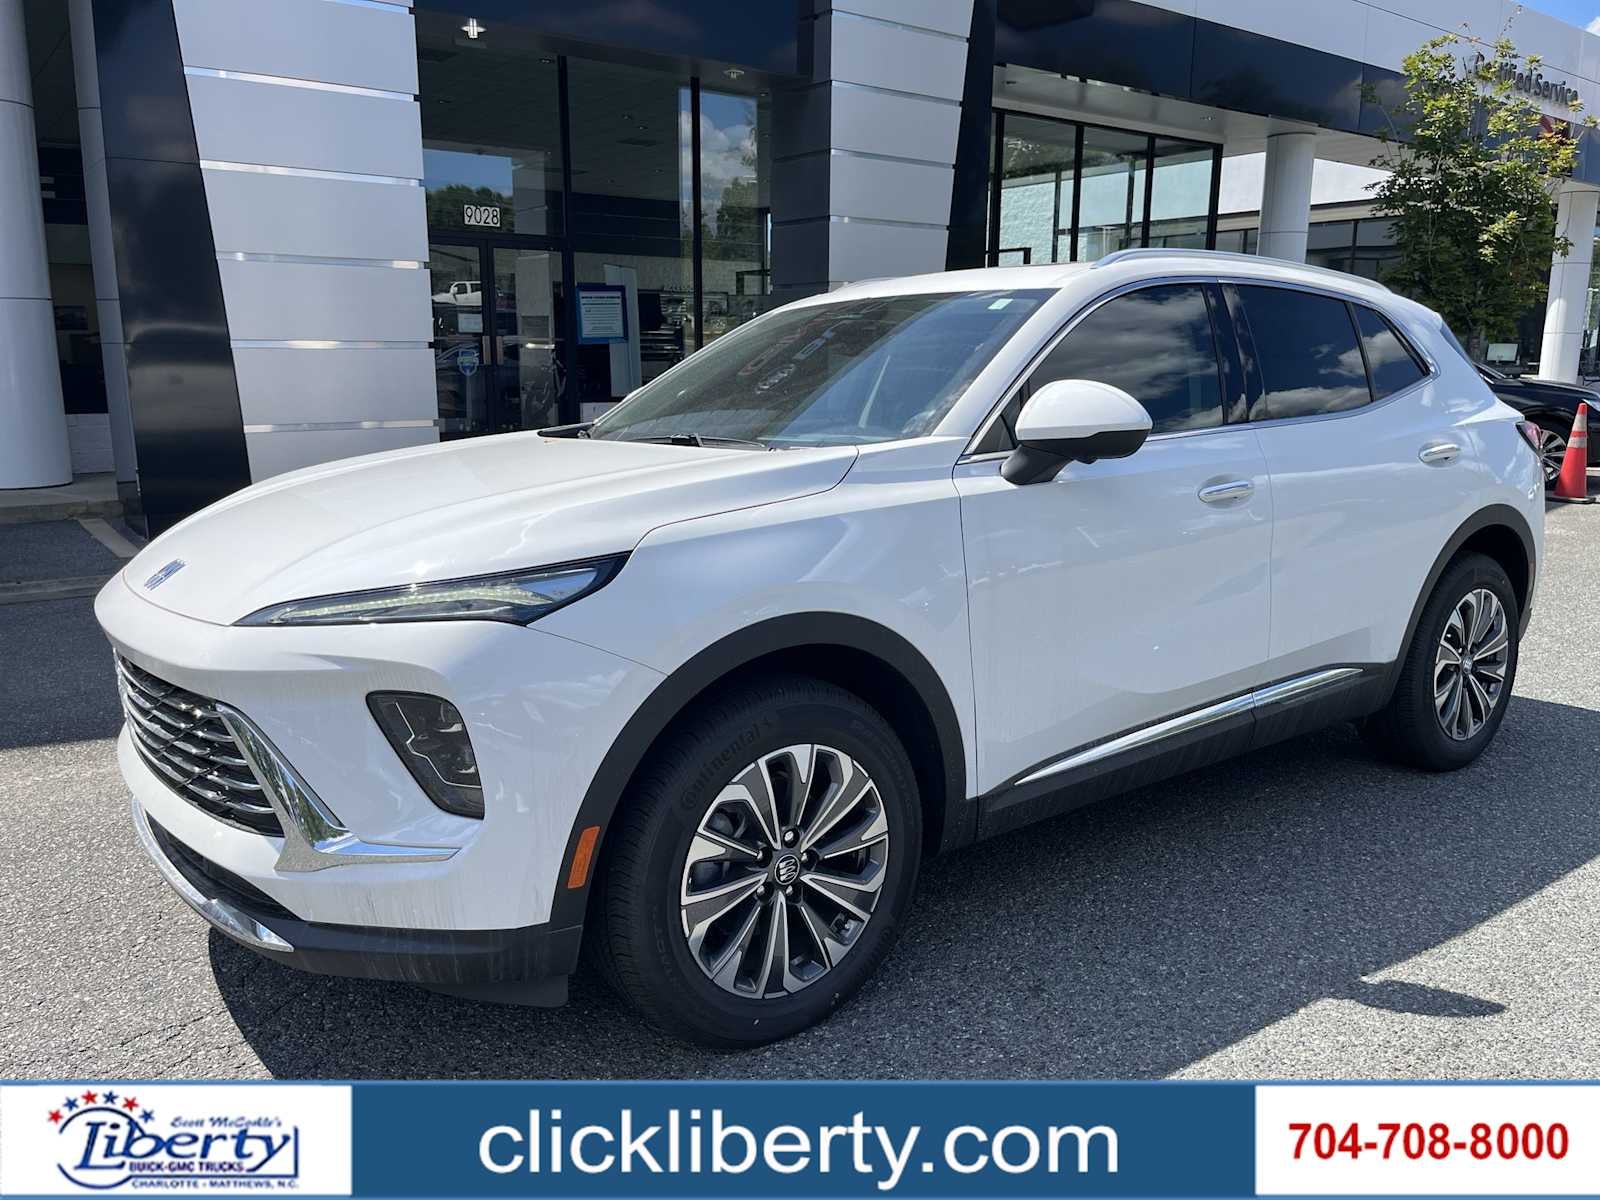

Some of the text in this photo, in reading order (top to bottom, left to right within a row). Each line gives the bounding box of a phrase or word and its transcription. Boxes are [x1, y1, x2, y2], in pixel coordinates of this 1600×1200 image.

[1474, 51, 1579, 106] Ctified Service
[465, 206, 499, 226] 9028
[680, 723, 761, 810] Continental
